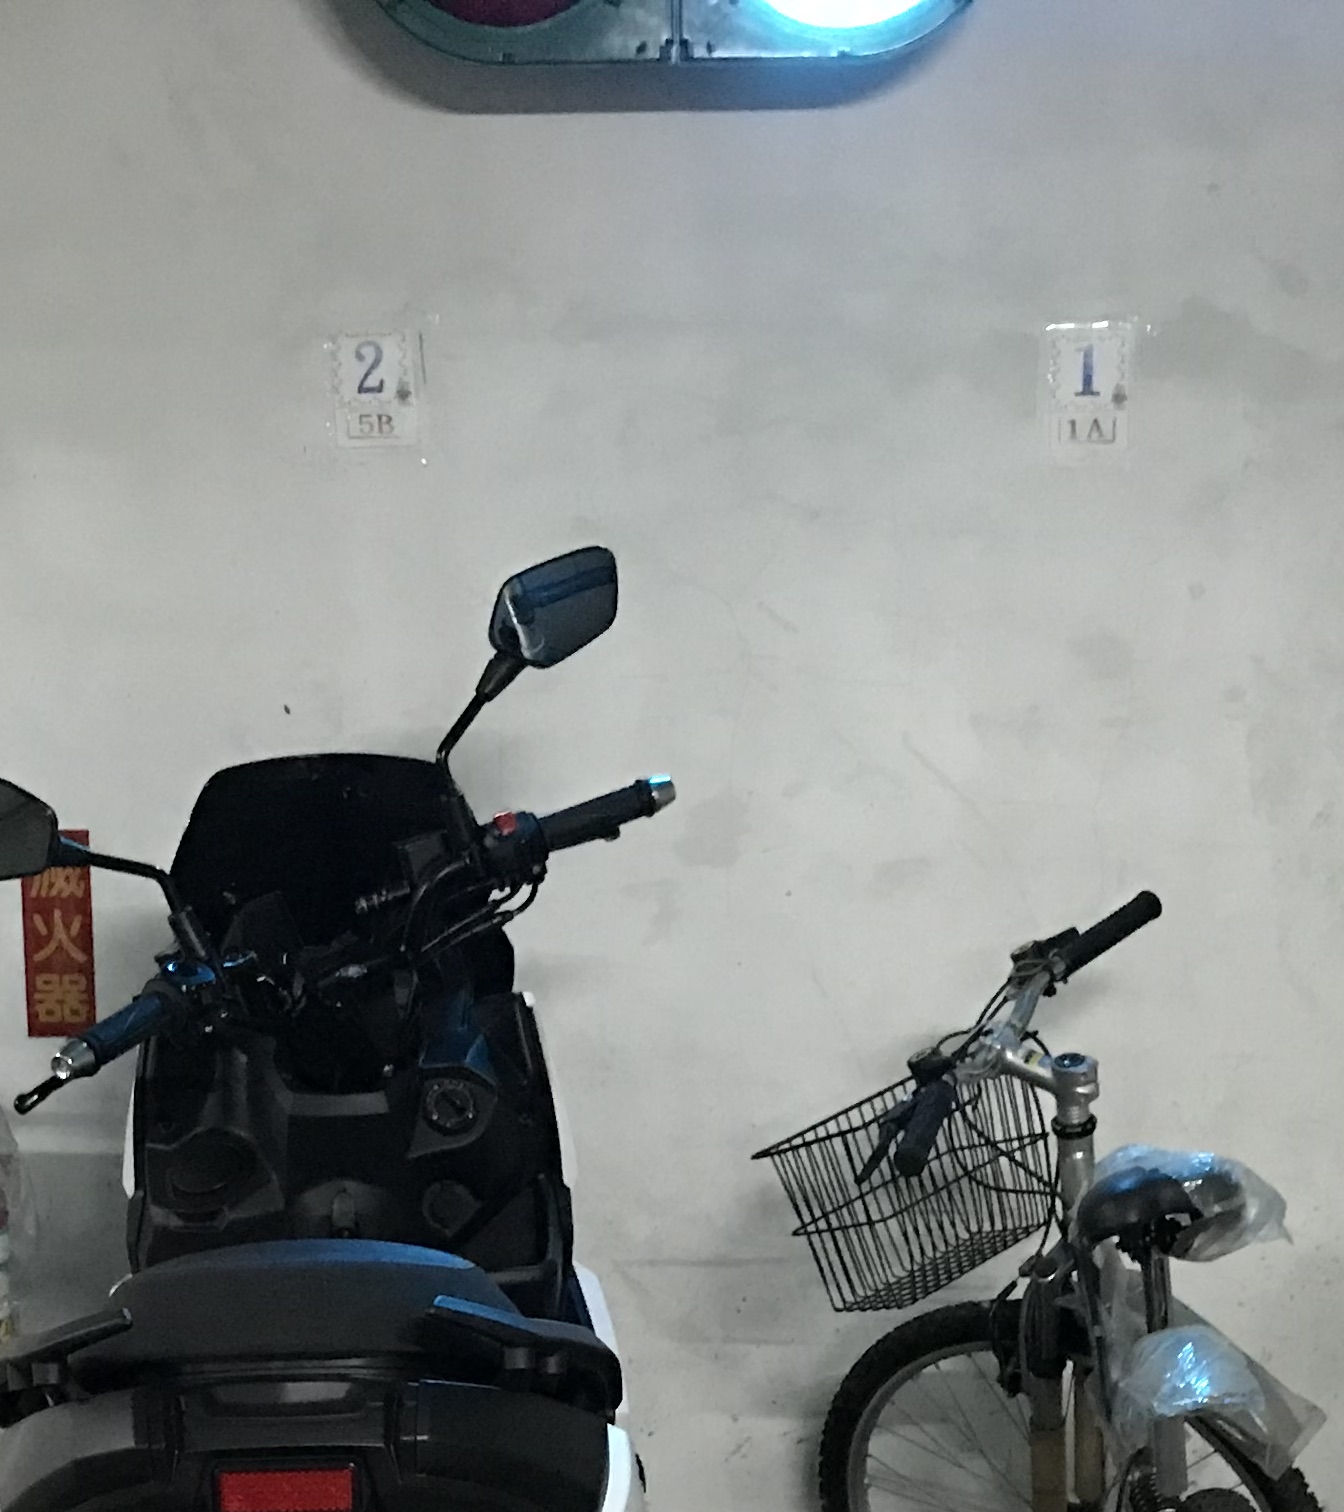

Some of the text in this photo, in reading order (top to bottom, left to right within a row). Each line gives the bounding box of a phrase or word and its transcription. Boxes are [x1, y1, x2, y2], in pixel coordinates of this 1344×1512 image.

[355, 340, 384, 394] 2
[1074, 343, 1101, 397] 1
[358, 413, 395, 435] 5B
